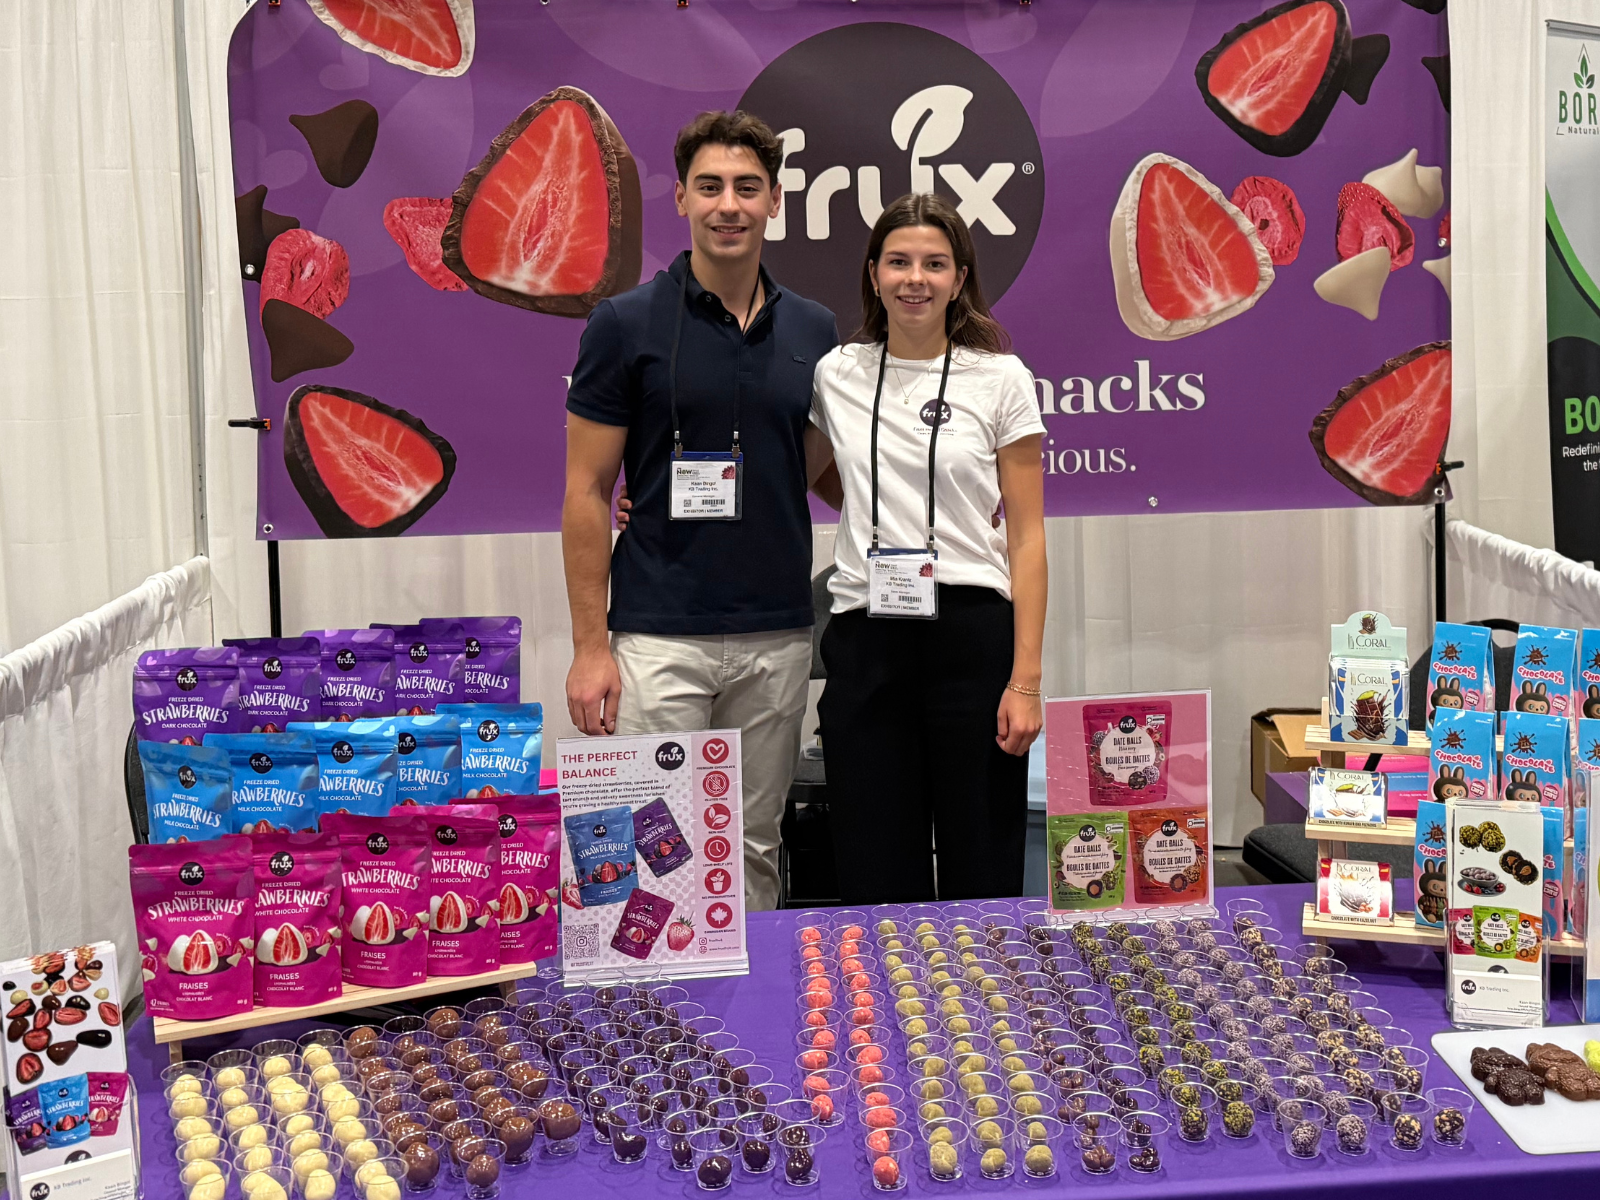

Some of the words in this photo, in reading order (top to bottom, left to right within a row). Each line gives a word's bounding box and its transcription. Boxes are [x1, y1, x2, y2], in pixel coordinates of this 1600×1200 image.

[1042, 439, 1136, 475] ious.
[1583, 459, 1598, 472] the
[1355, 635, 1391, 649] CORAL
[410, 645, 428, 657] frux
[336, 652, 355, 664] frux
[263, 660, 282, 672] frux
[1432, 661, 1477, 680] CHOCOLATE
[177, 671, 199, 685] frux
[464, 671, 510, 690] BERRIES
[1357, 673, 1387, 685] CORAL
[1517, 666, 1565, 686] CHOCOLATE
[395, 674, 455, 695] AWBERRIES
[142, 703, 229, 726] STRAWBERRIES
[479, 723, 498, 736] frux
[1119, 719, 1136, 729] frux
[1113, 737, 1125, 746] DATE
[1126, 736, 1142, 745] BALLS
[333, 744, 353, 756] frux
[657, 746, 684, 763] frux
[251, 757, 272, 768] frux
[561, 753, 585, 764] THE
[587, 750, 638, 763] PERFECT
[1105, 756, 1124, 765] BOULES
[1124, 755, 1131, 764] DE
[1132, 754, 1150, 763] DATTES
[1434, 750, 1483, 770] CHOCOLATE
[1505, 754, 1556, 774] CHOCOLATE
[397, 767, 450, 786] BERRIES
[562, 767, 617, 780] BALANCE
[1337, 771, 1365, 781] CORAL
[318, 775, 385, 797] AWBERRIES
[231, 786, 306, 808] RAWBERRIES
[174, 821, 199, 831] CHOCOLATE
[1079, 827, 1096, 837] frux
[1162, 822, 1177, 832] frux
[436, 828, 457, 839] frux
[638, 823, 673, 847] STRAWBERRIES
[367, 836, 388, 848] frux
[1086, 844, 1101, 852] BALLS
[1156, 840, 1167, 848] DATE
[1168, 839, 1184, 847] BALLS
[577, 843, 629, 860] STRAWBERRIES
[270, 854, 293, 869] frux
[501, 850, 551, 869] BERRIES
[1066, 863, 1084, 871] BOULES
[1084, 862, 1091, 870] DE
[1092, 861, 1110, 869] DATTES
[1148, 858, 1166, 866] BOULES
[1167, 857, 1173, 865] DE
[1174, 856, 1191, 864] DATTES
[180, 865, 204, 880] frux
[431, 857, 491, 879] WBERRIES
[1343, 863, 1372, 874] CORAL
[341, 867, 420, 891] TRAWBERRIES
[254, 888, 331, 908] AWBERRIES
[147, 896, 245, 921] STRAWBERRIES
[274, 907, 309, 915] CHOCOLATE
[167, 915, 187, 923] WHITE
[187, 914, 223, 923] CHOCOLATE
[432, 940, 460, 948] FRAISES
[361, 951, 386, 959] FRAISES
[179, 982, 209, 990] FRAISES
